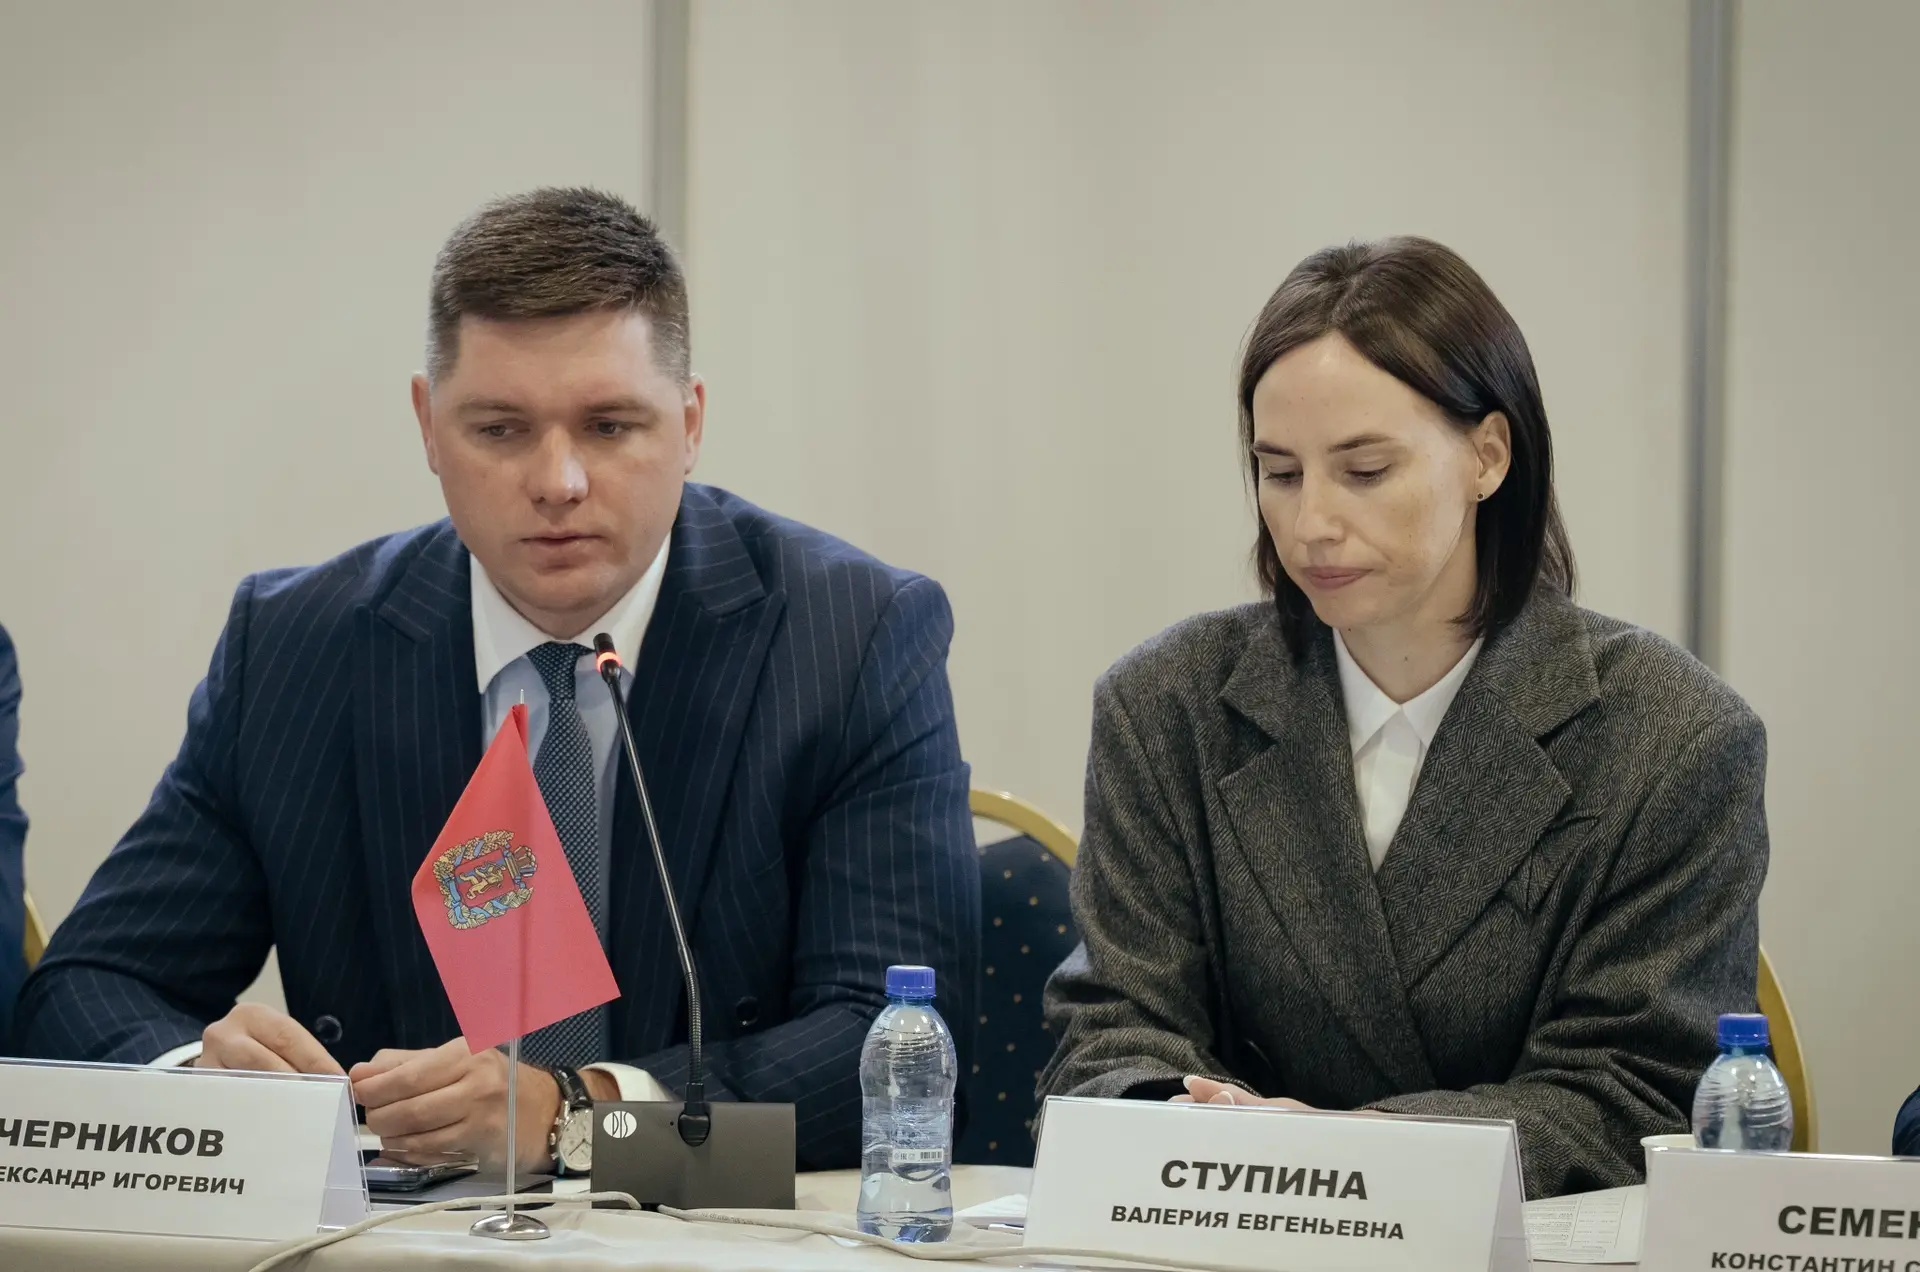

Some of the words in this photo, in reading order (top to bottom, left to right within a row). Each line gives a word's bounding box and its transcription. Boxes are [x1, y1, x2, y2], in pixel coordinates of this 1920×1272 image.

[0, 1117, 224, 1157] ЧЕРНИКОВ
[112, 1172, 245, 1195] ИГОРЕВИЧ
[1161, 1159, 1368, 1201] СТУПИНА
[1111, 1205, 1229, 1229] ВАЛЕРИЯ
[1237, 1213, 1404, 1240] ЕВГЕНЬЕВНА
[1711, 1251, 1895, 1272] КОНСТАНТИН
